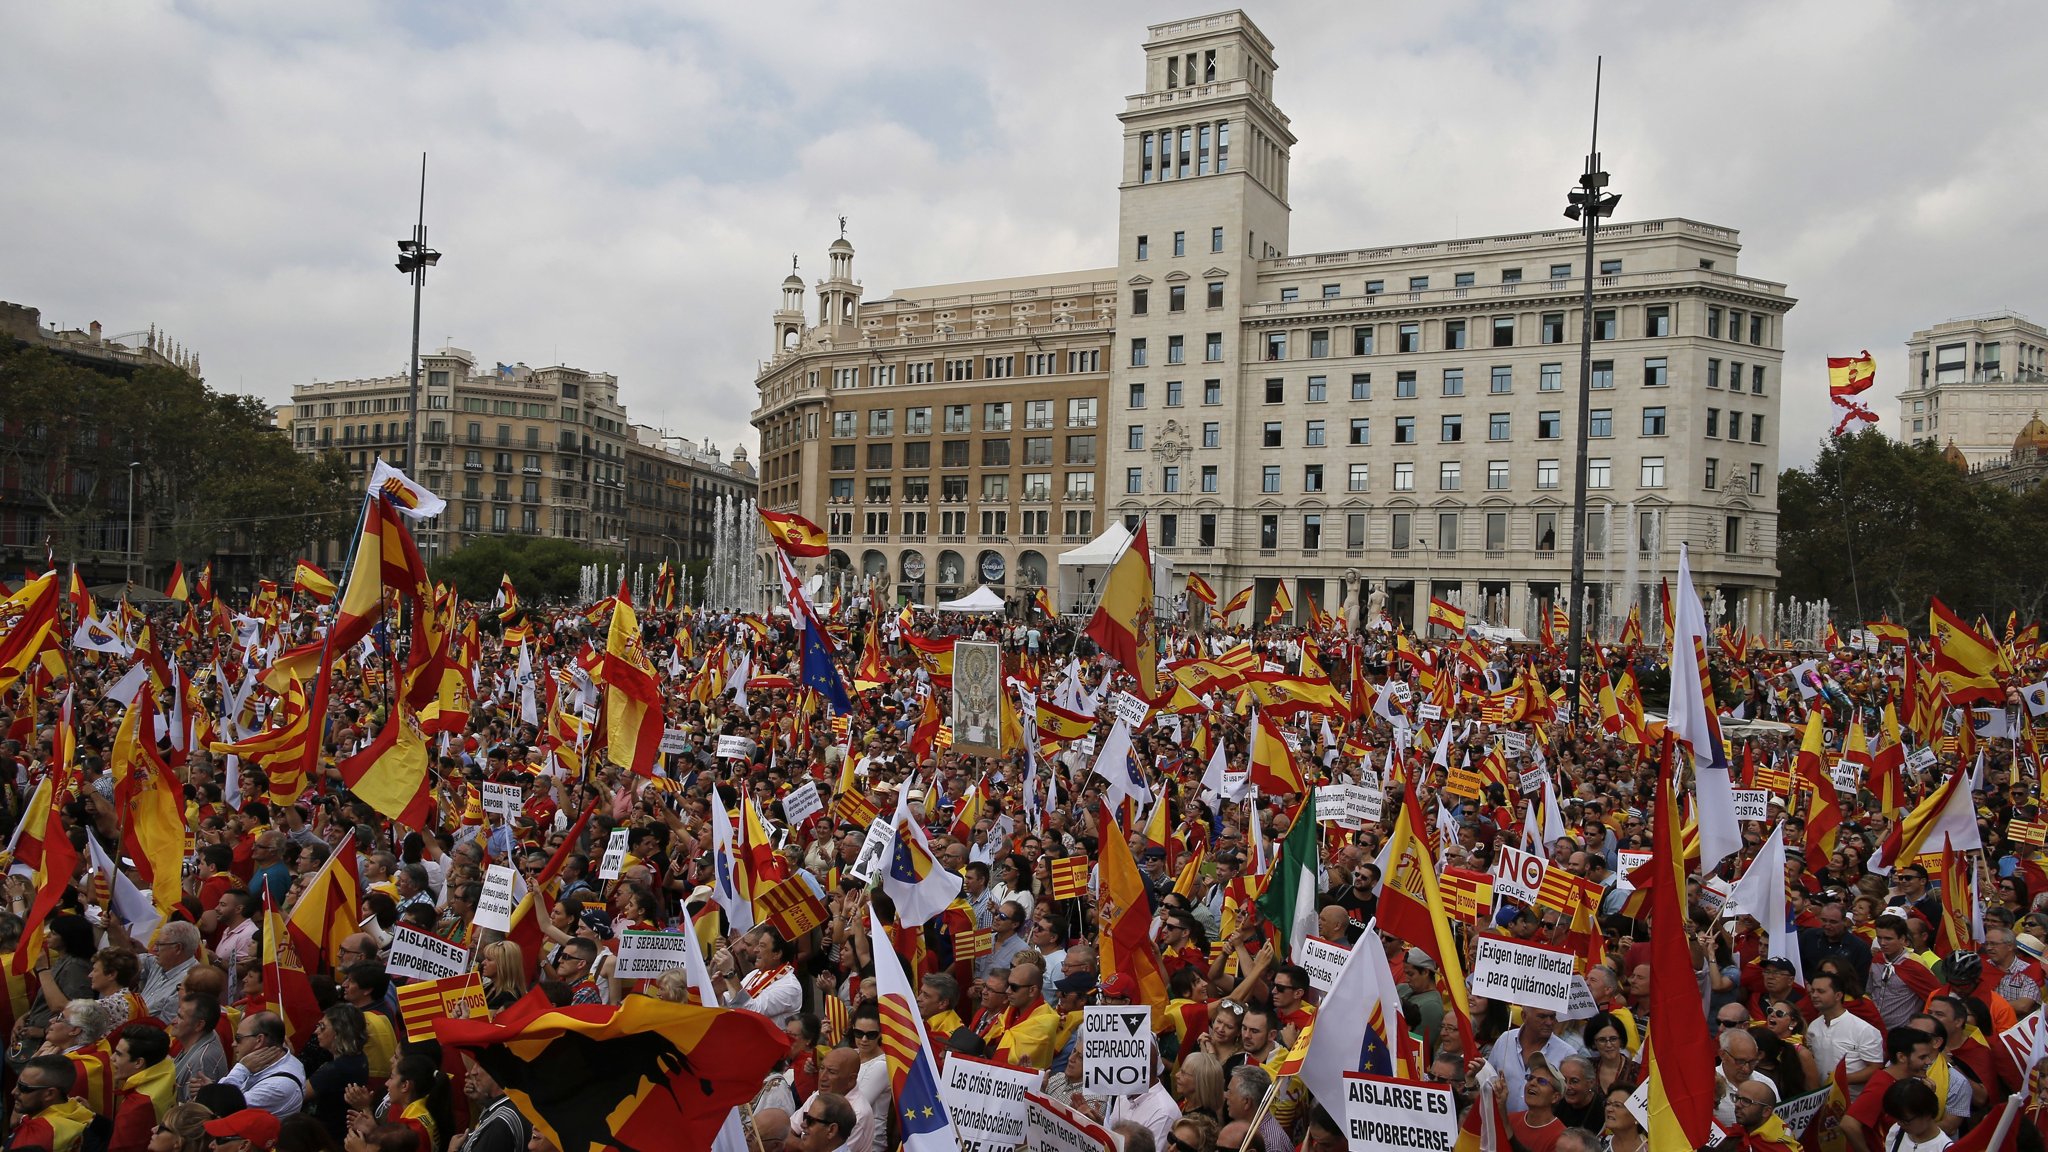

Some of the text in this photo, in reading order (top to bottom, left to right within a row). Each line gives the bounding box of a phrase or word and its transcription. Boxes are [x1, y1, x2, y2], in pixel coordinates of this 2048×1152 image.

[904, 562, 925, 570] Desigual
[512, 789, 520, 798] ES
[1499, 847, 1543, 890] NO
[1463, 895, 1475, 910] TODOS
[1496, 883, 1527, 900] ¡GOLPE,
[397, 929, 463, 964] AISLARSE ES
[622, 936, 633, 949] NI
[1315, 947, 1326, 960] usa
[618, 958, 629, 971] NI
[1479, 942, 1572, 975] ¡Exigen tener libertad
[1487, 971, 1508, 987] para
[1511, 975, 1569, 1000] quitárnosla!
[1086, 1014, 1118, 1032] GOLPE
[1085, 1039, 1147, 1061] SEPARADOR,
[950, 1065, 967, 1090] Las
[969, 1071, 992, 1095] crisis
[1085, 1066, 1147, 1088] ¡NO!
[1348, 1082, 1448, 1114] AISLARSE ES
[1027, 1105, 1056, 1135] ¡Exigen
[1057, 1121, 1077, 1146] tener
